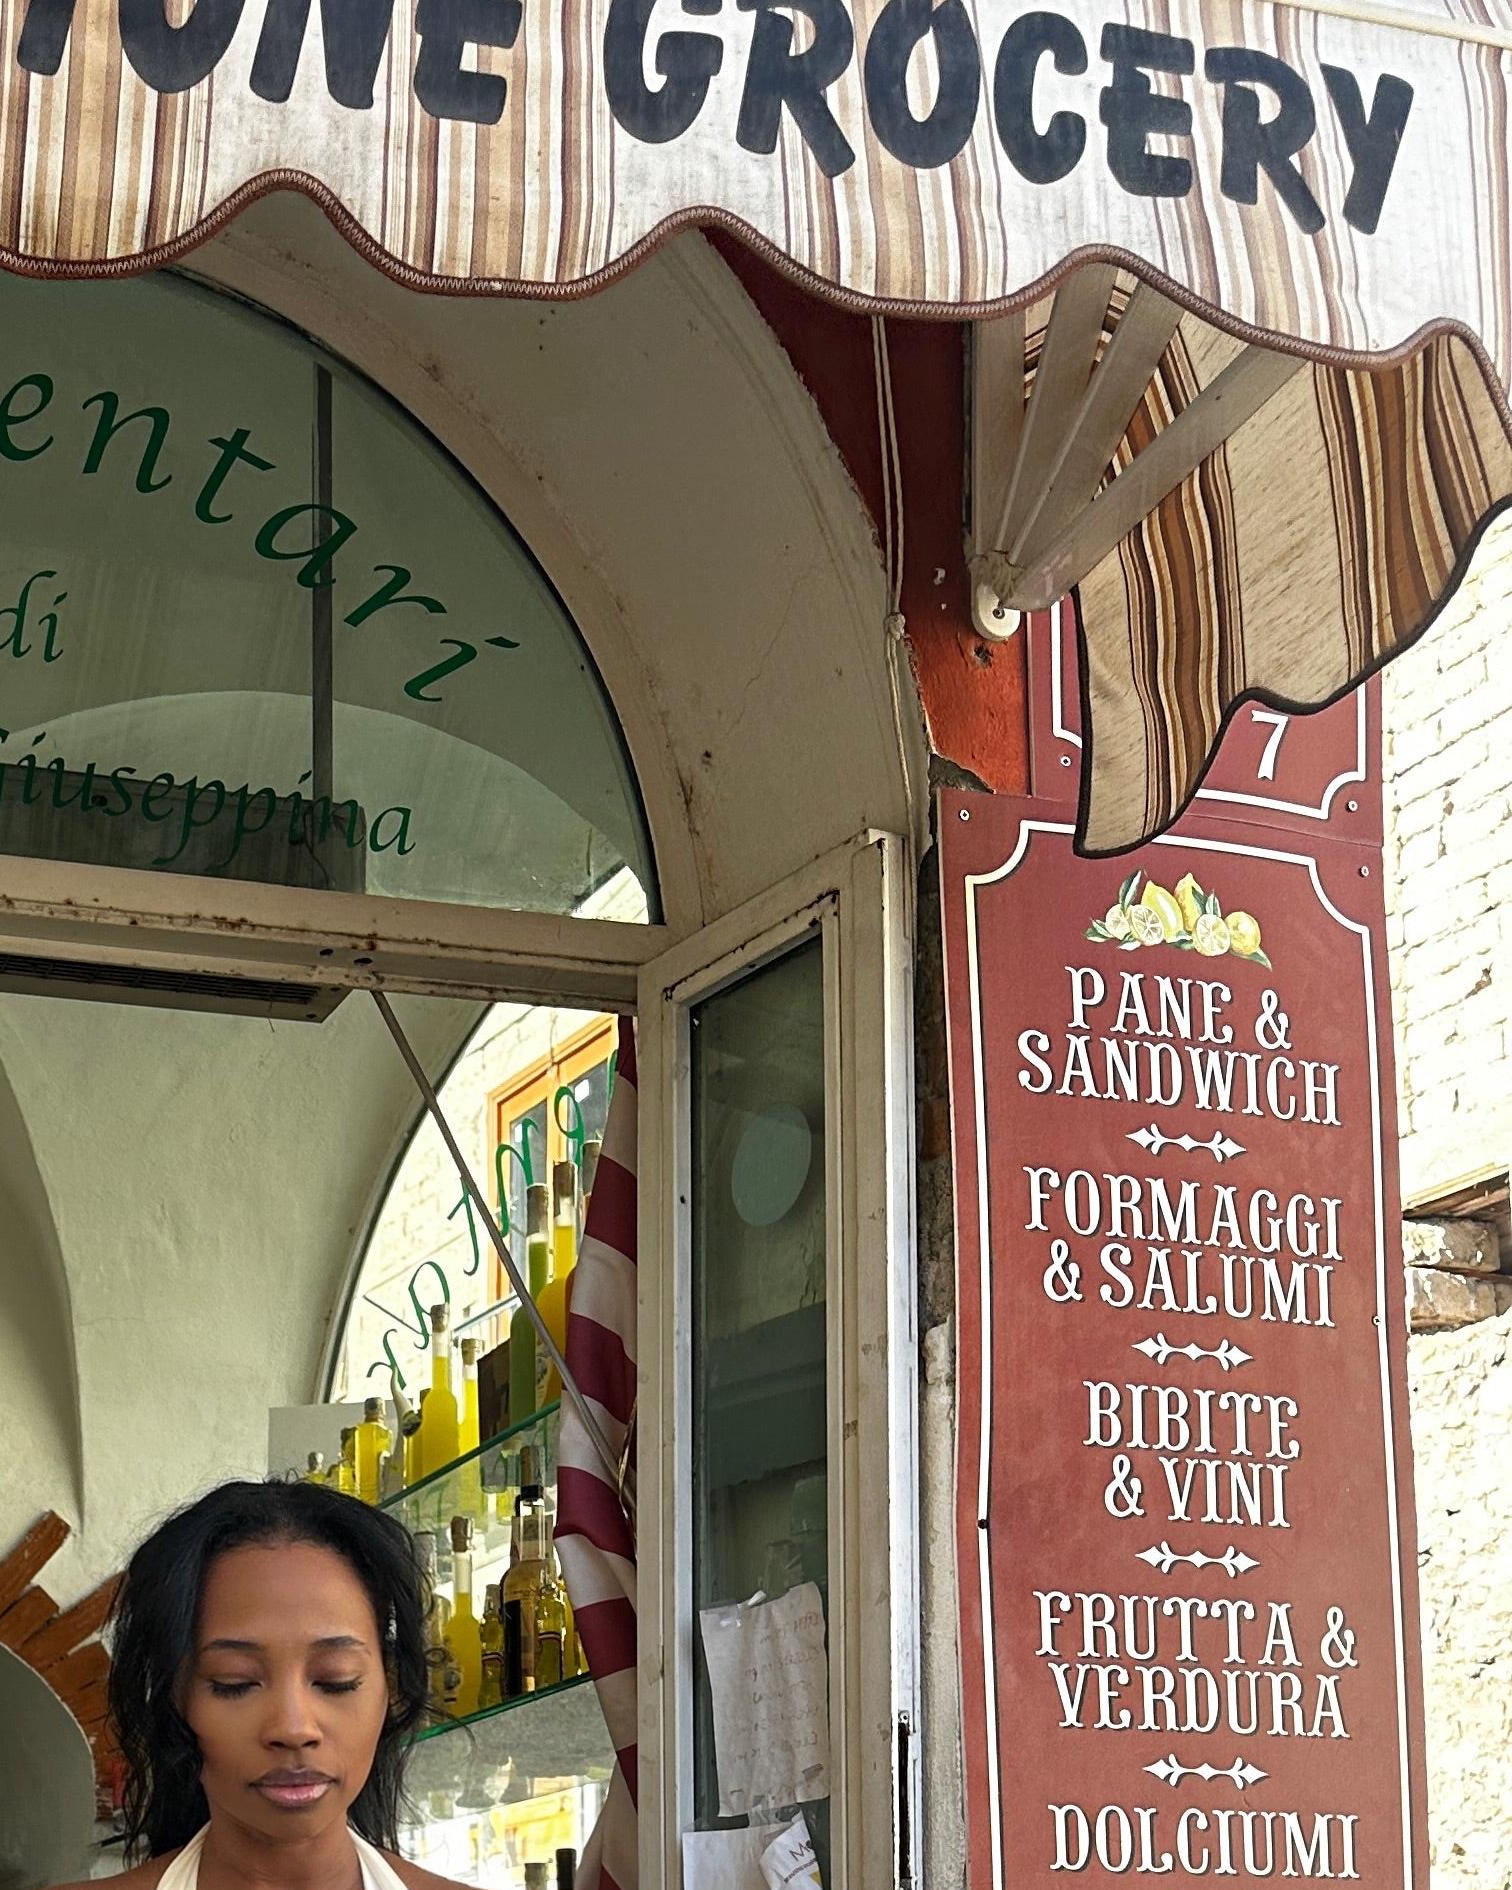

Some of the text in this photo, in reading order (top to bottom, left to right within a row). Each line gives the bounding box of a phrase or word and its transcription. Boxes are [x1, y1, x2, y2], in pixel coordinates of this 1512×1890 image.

[603, 0, 1415, 236] GROCERY
[1251, 711, 1289, 780] 7
[1065, 966, 1292, 1051] PANE &
[1017, 1031, 1342, 1126] SANDWICH
[1023, 1166, 1344, 1261] FORMAGGI
[1043, 1239, 1336, 1328] & SALUMI
[1083, 1380, 1301, 1460] BIBITE
[1104, 1454, 1292, 1528] & VINI
[1033, 1591, 1358, 1668] FRUTTA &
[1048, 1662, 1350, 1738] VERDURA
[1048, 1804, 1360, 1879] DOLCIUMI
